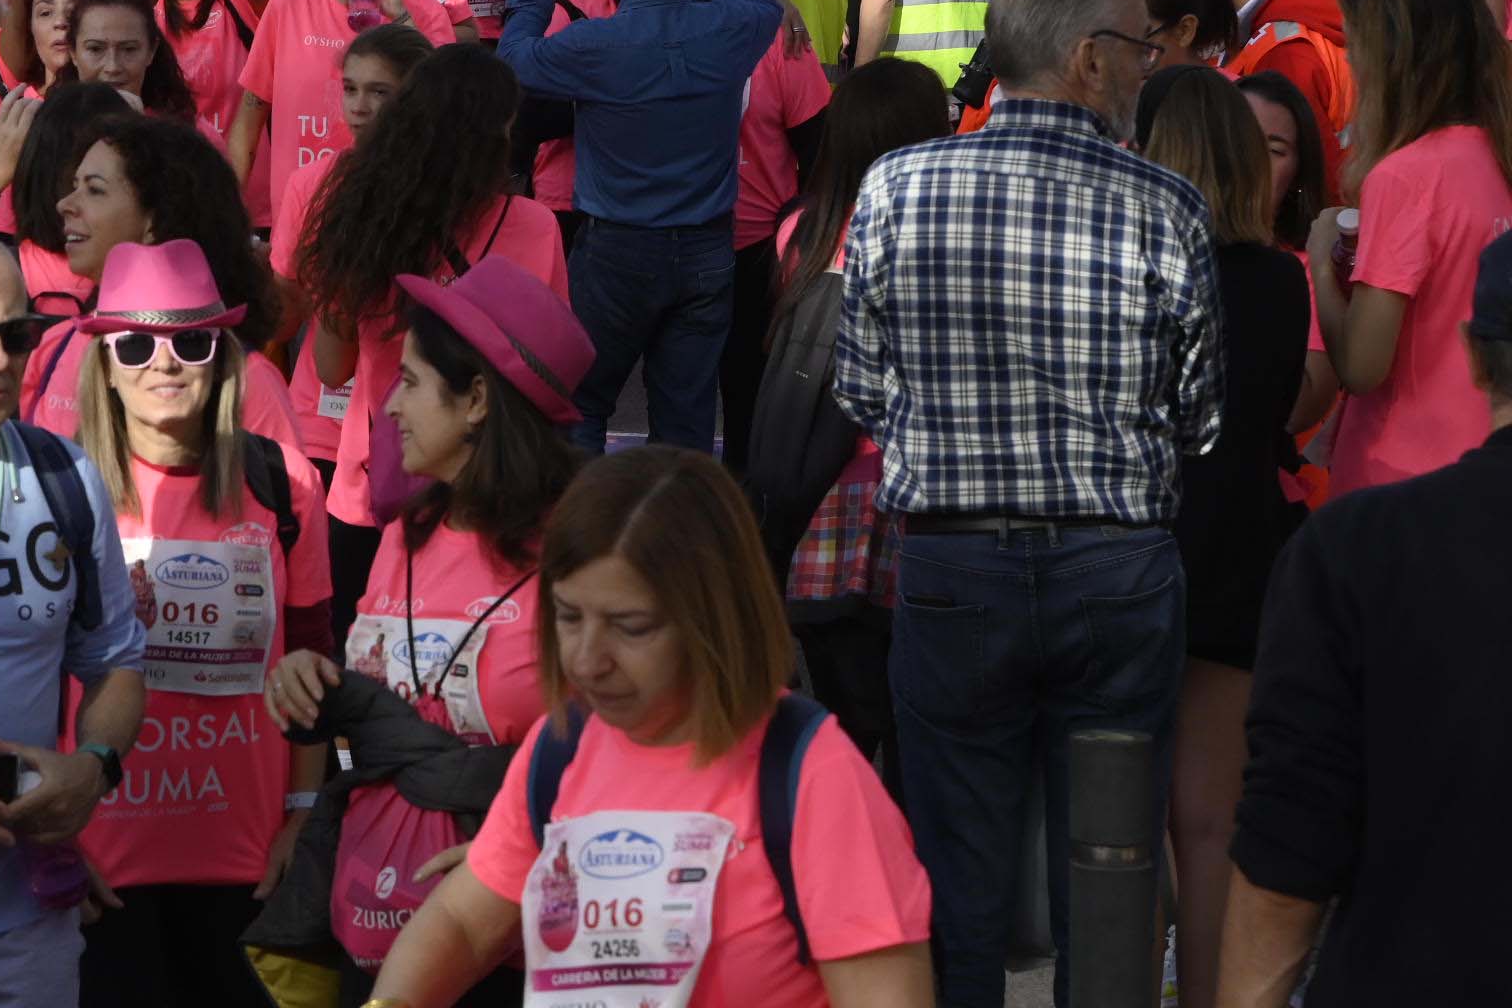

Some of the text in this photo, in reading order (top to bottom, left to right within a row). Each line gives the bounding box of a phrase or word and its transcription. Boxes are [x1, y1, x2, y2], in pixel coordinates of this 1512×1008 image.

[303, 35, 345, 49] OYSHO
[298, 114, 328, 138] TU
[160, 570, 224, 582] ASTURIANA
[162, 600, 220, 626] 016
[167, 630, 211, 646] 14517
[134, 708, 260, 753] ORSAL
[585, 848, 656, 867] ASTURIANA
[352, 906, 413, 930] ZURIC
[583, 897, 644, 929] 016
[590, 940, 640, 960] 24256
[551, 969, 602, 985] CARRERA
[603, 968, 617, 982] DE
[619, 967, 634, 981] LA
[635, 966, 668, 981] MUJER
